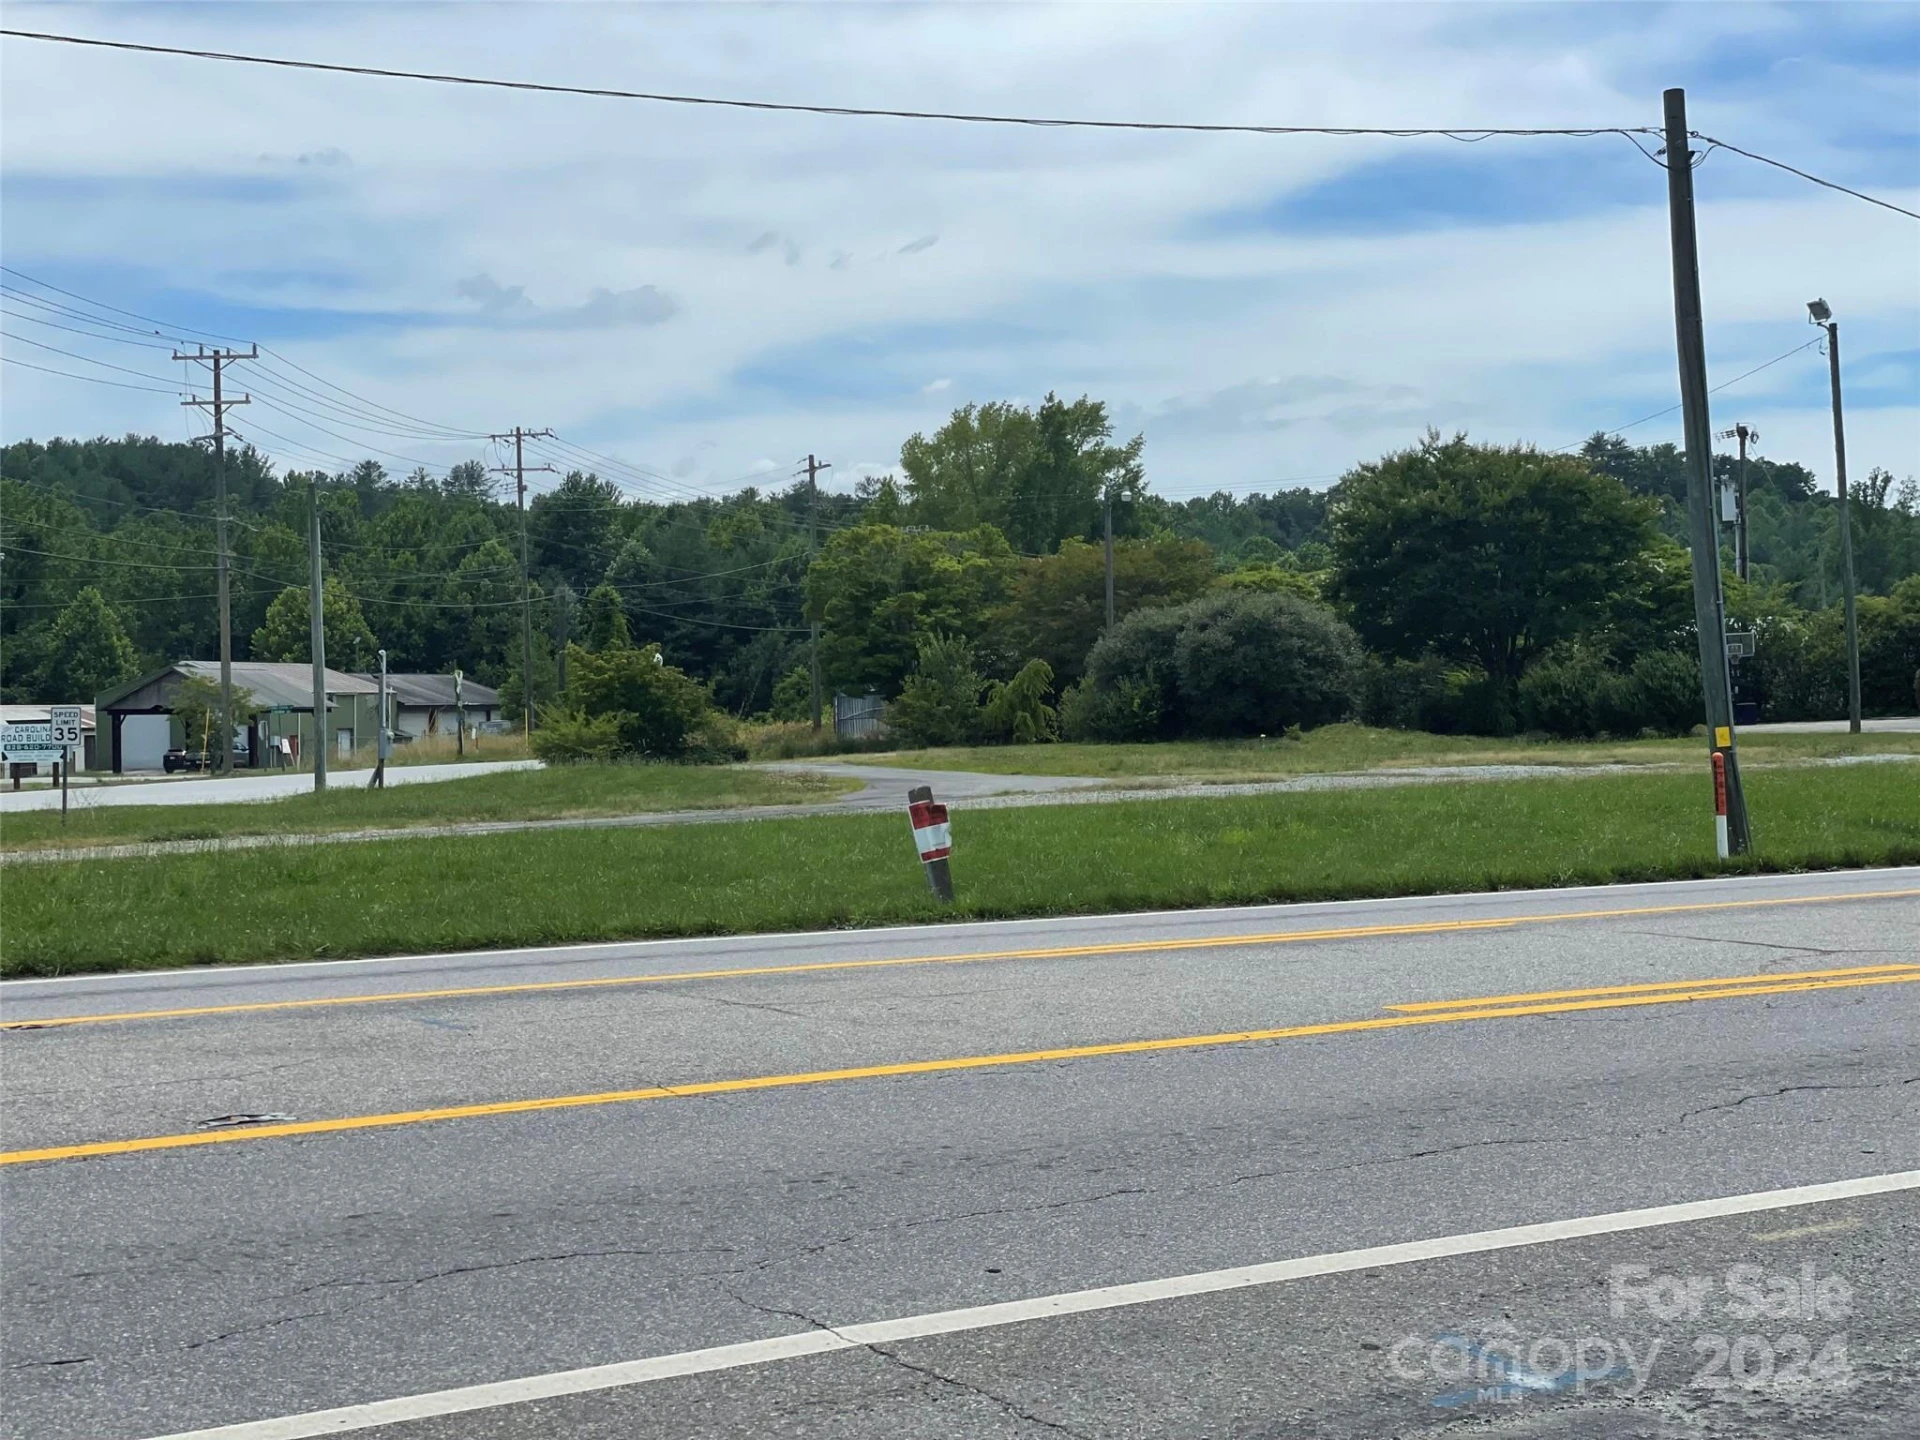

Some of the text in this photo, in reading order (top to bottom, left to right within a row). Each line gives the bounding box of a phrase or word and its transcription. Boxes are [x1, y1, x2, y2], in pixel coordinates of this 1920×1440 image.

[1, 734, 51, 742] ROAD BUILD
[54, 727, 78, 741] 35
